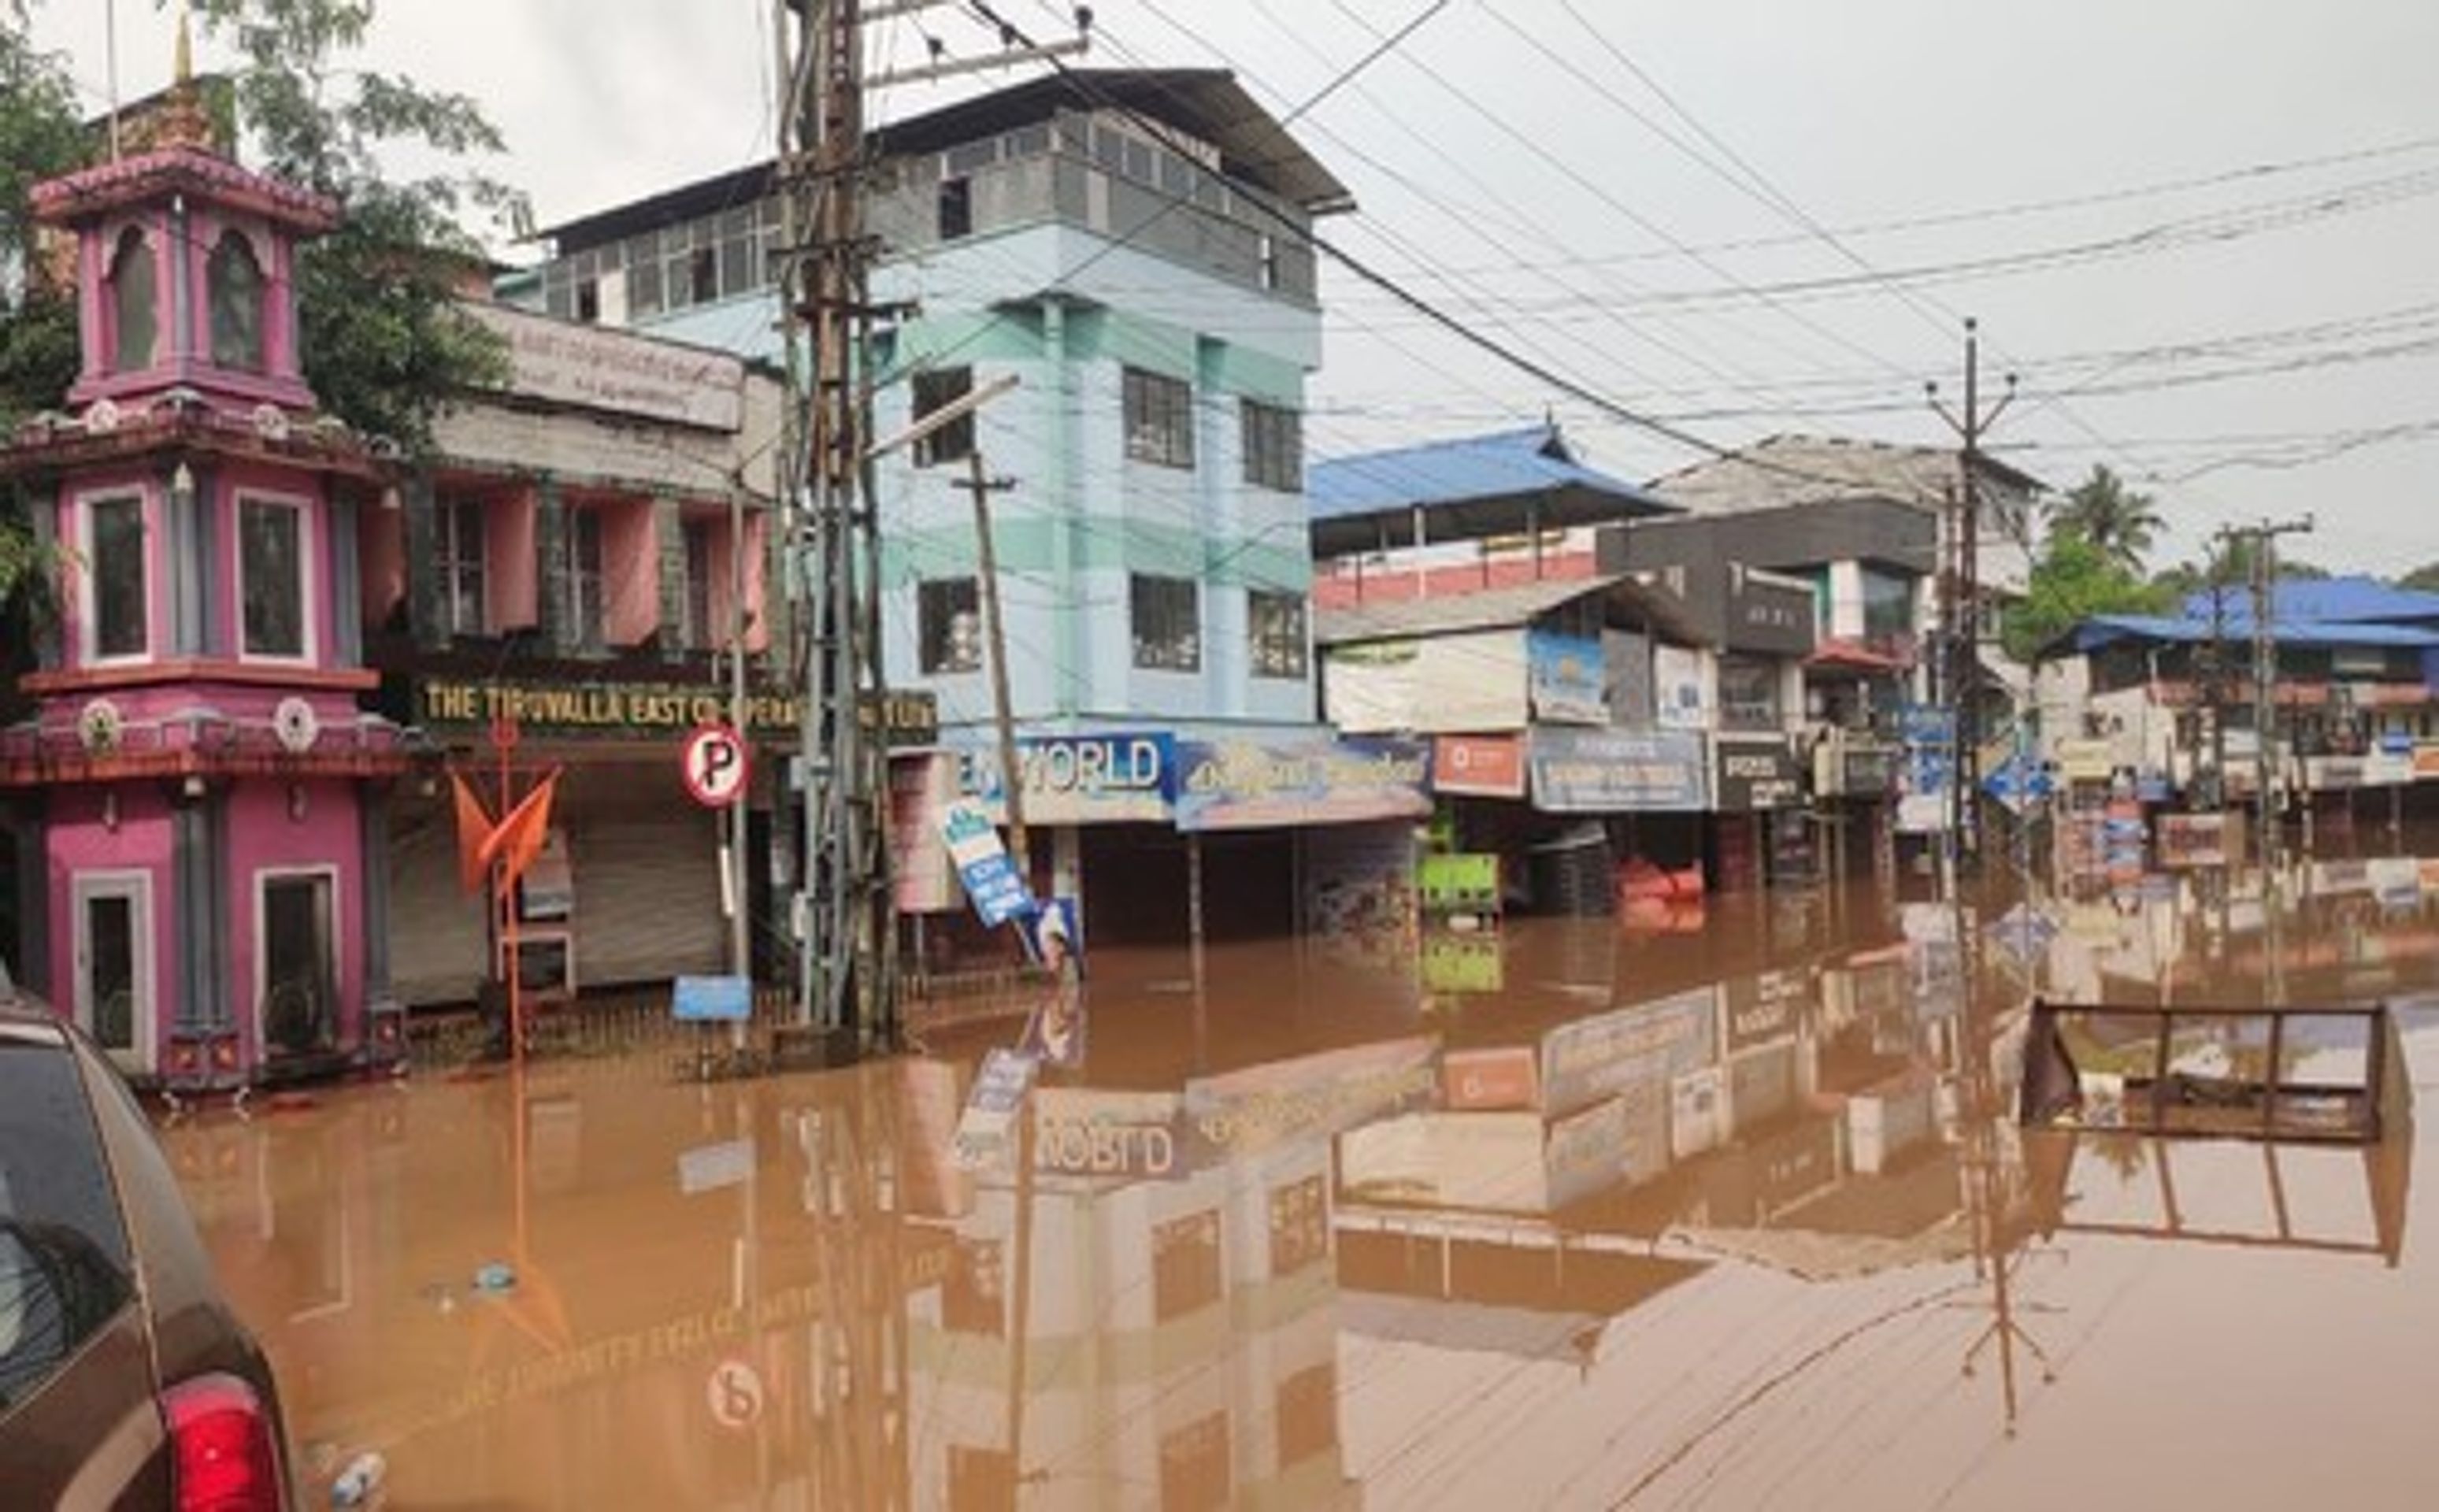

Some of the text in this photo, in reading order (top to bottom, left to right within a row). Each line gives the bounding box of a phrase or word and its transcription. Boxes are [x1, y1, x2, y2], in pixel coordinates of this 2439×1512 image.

[427, 682, 476, 718] THE
[632, 693, 686, 725] EAST
[702, 740, 733, 789] P
[1015, 739, 1161, 791] WORLD
